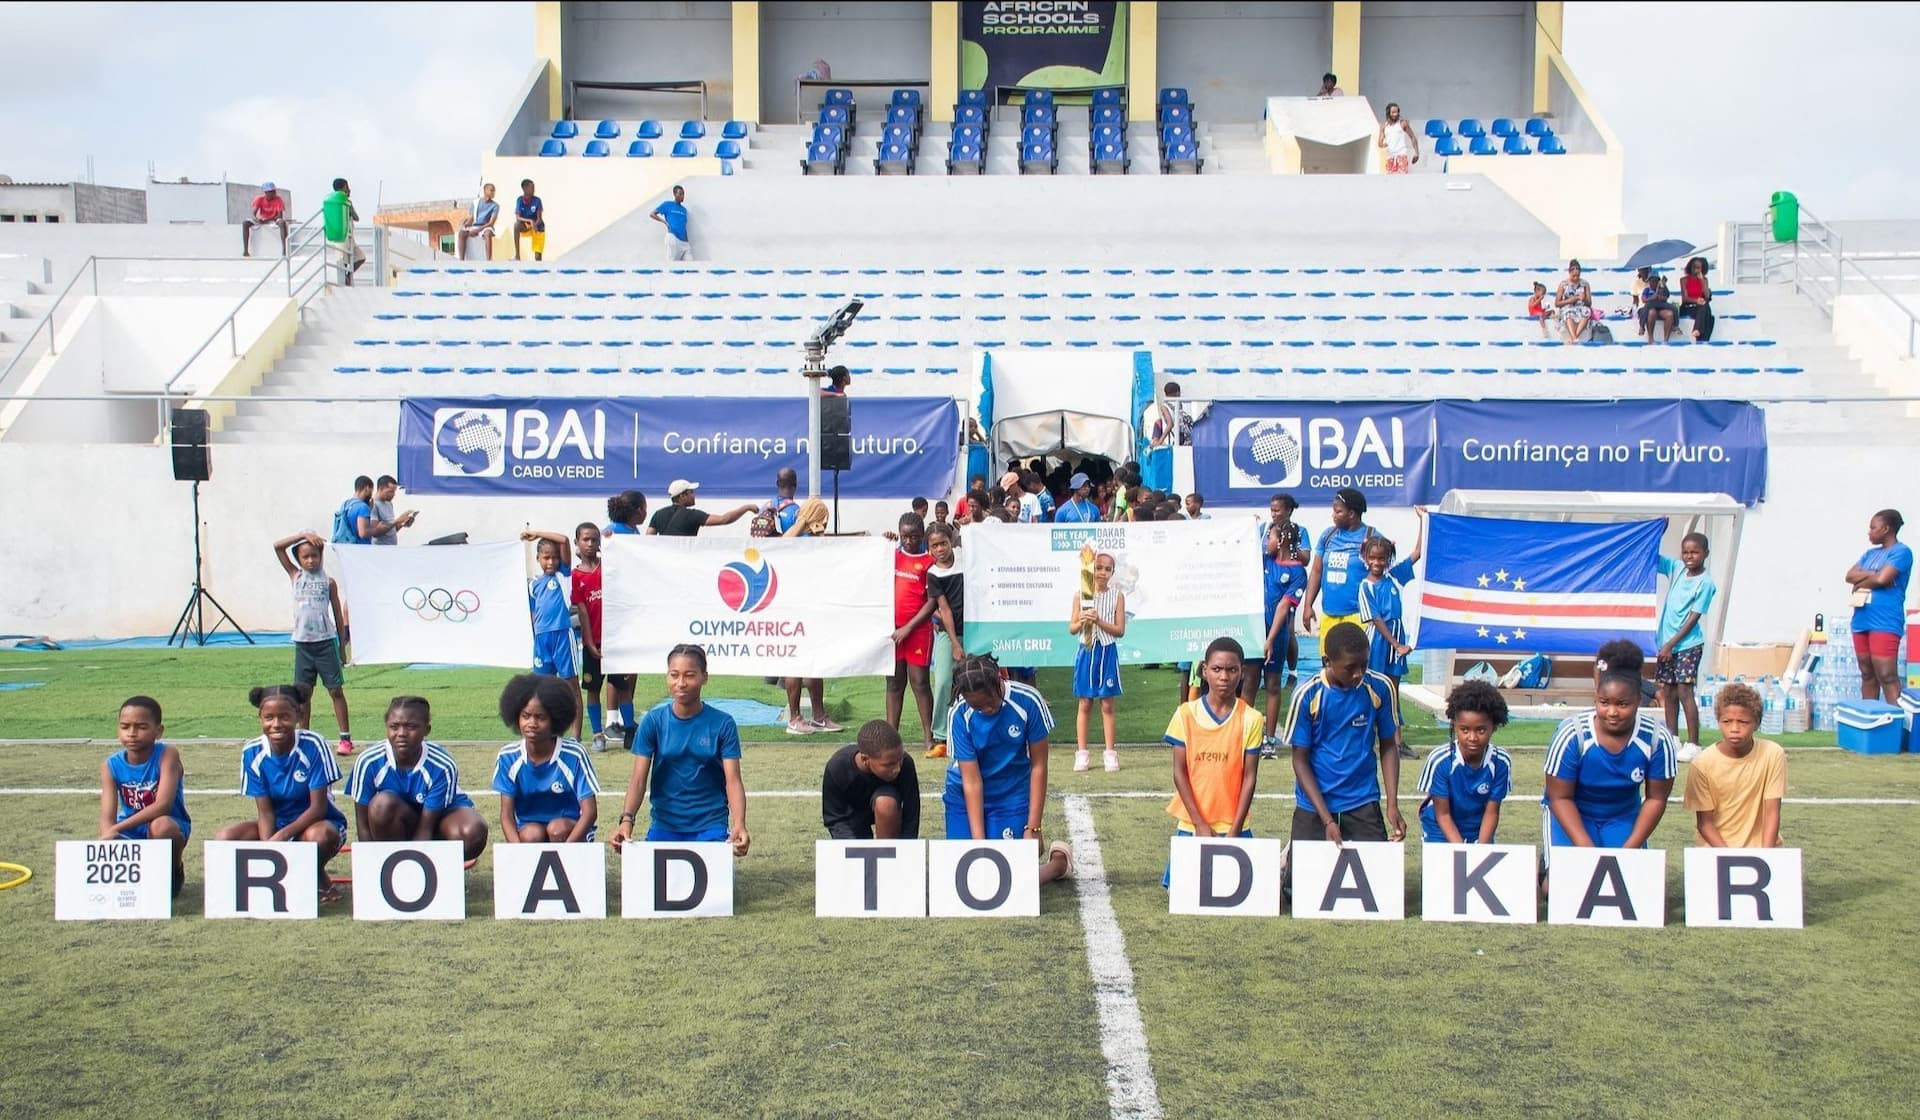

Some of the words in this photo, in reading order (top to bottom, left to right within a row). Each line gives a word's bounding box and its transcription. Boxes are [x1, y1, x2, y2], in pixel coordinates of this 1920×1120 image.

[983, 13, 1100, 25] SCHOOLS
[982, 25, 1100, 35] PROGRAMME
[512, 409, 605, 460] BAI
[663, 432, 786, 459] Confiança
[797, 441, 810, 454] n
[852, 435, 924, 455] uturo.
[1308, 417, 1403, 470] BAI
[1462, 438, 1589, 468] Confiança
[1598, 443, 1630, 463] no
[1639, 440, 1730, 463] Futuro.
[513, 466, 553, 479] CABO
[557, 466, 605, 479] VERDE
[1310, 475, 1351, 488] CABO
[1355, 475, 1404, 488] VERDE
[1053, 531, 1067, 540] ONE
[1097, 528, 1125, 538] DAKAR
[1097, 538, 1125, 550] 2026
[689, 620, 806, 637] OLYMPAFRICA
[755, 644, 798, 658] CRUZ
[992, 639, 1022, 652] SANTA
[1024, 638, 1053, 651] CRUZ
[86, 844, 141, 862] DAKAR
[86, 863, 141, 884] 2026
